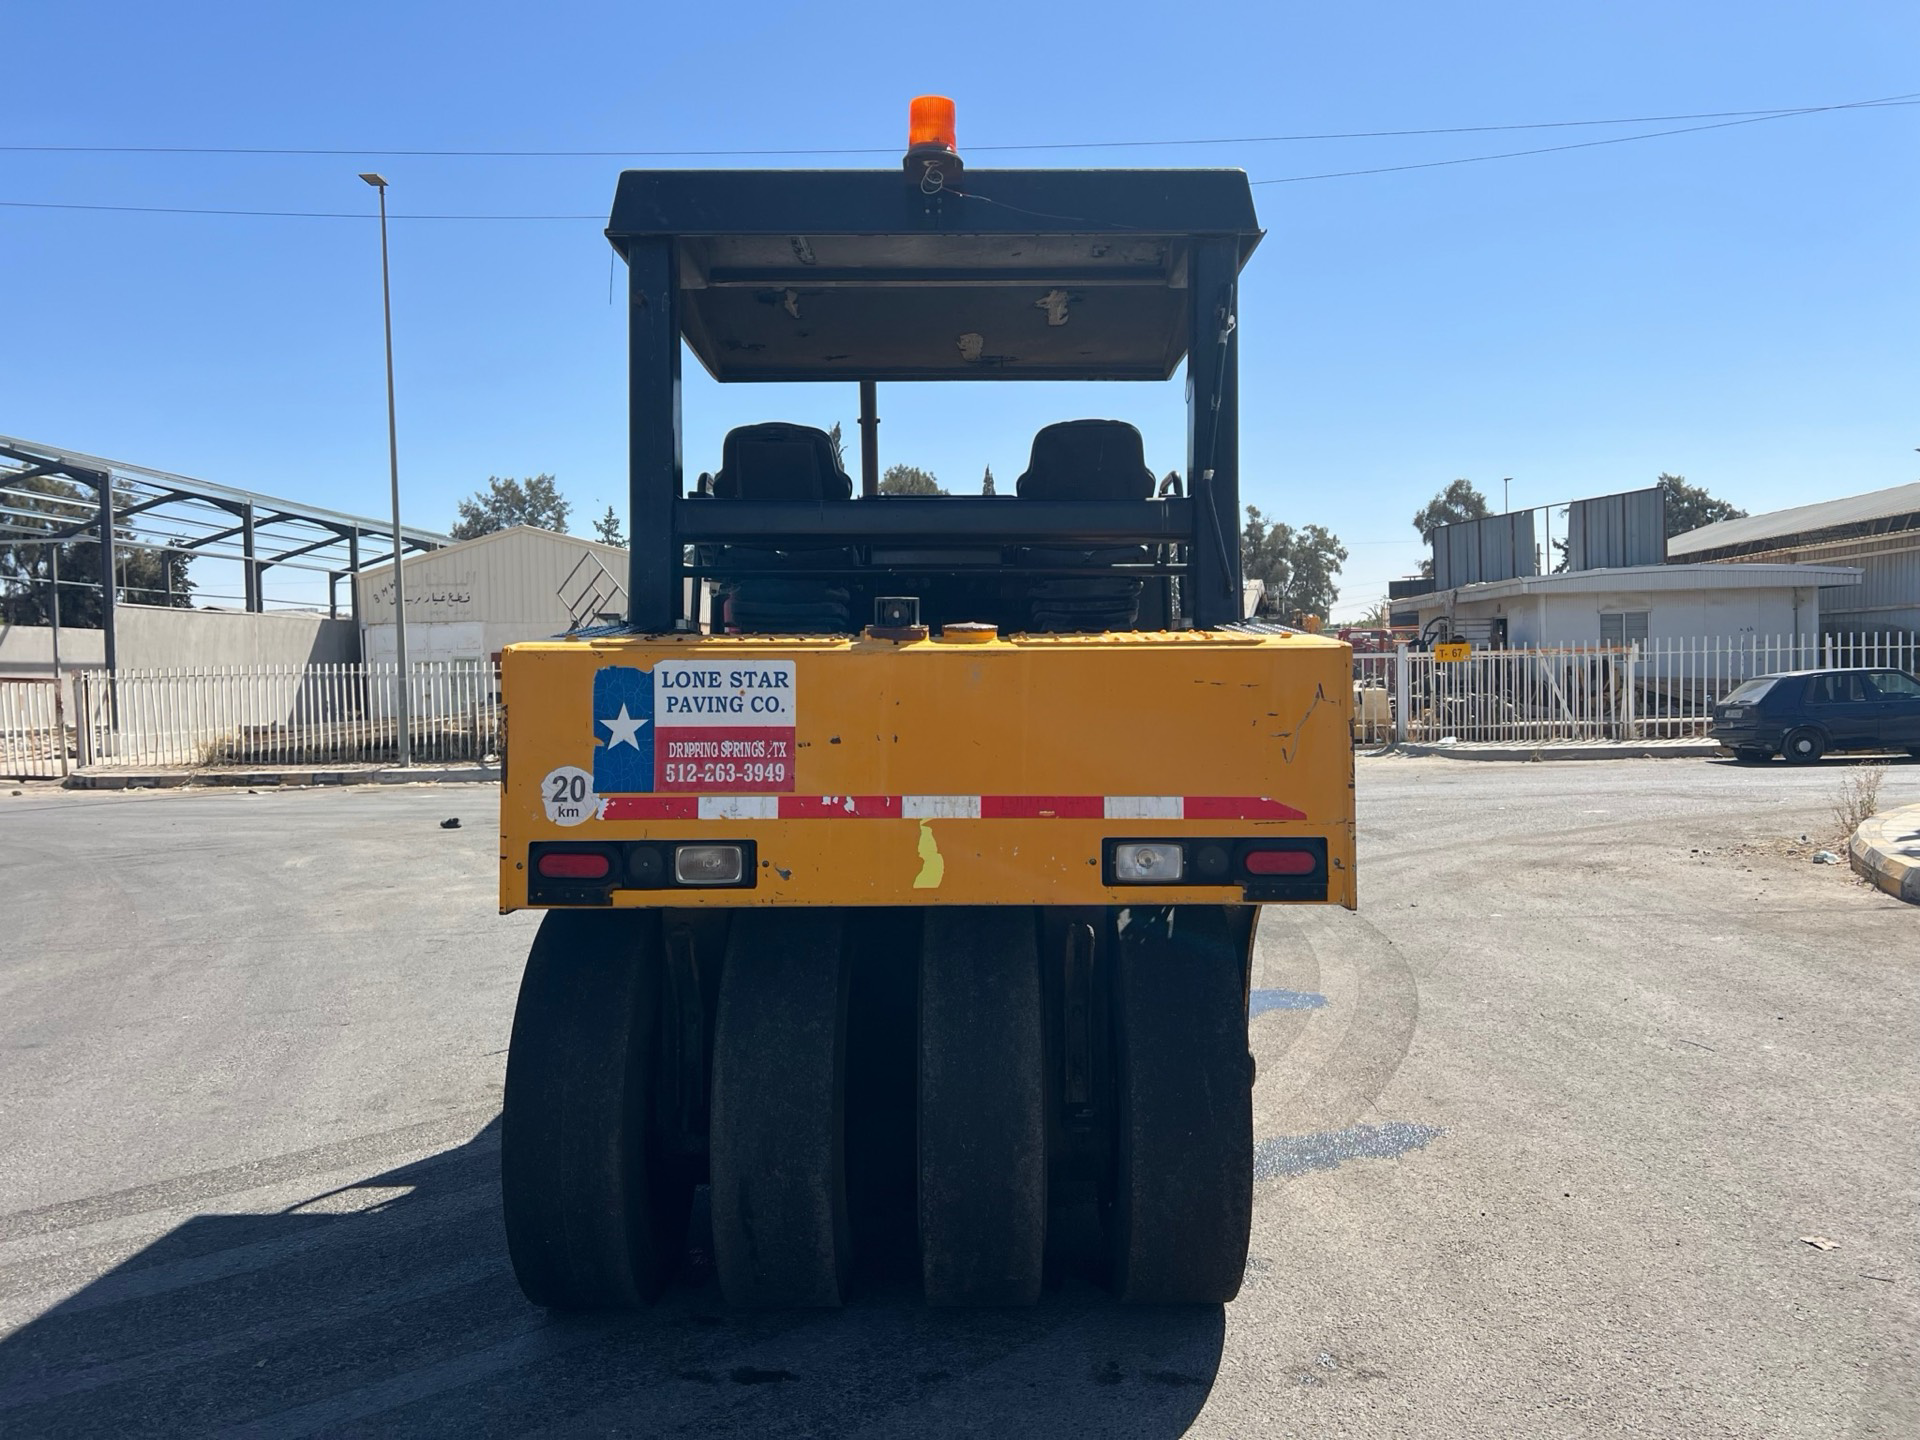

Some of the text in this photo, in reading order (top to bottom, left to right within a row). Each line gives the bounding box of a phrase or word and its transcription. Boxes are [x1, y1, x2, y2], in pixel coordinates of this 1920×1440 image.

[447, 592, 471, 607] قطع
[1452, 648, 1462, 658] 67
[662, 671, 789, 688] LONE STAR
[666, 695, 786, 713] PAVING CO.
[668, 742, 719, 758] DRIPPING
[666, 763, 785, 783] 512-263-3949
[551, 775, 586, 803] 20
[557, 807, 580, 818] km
